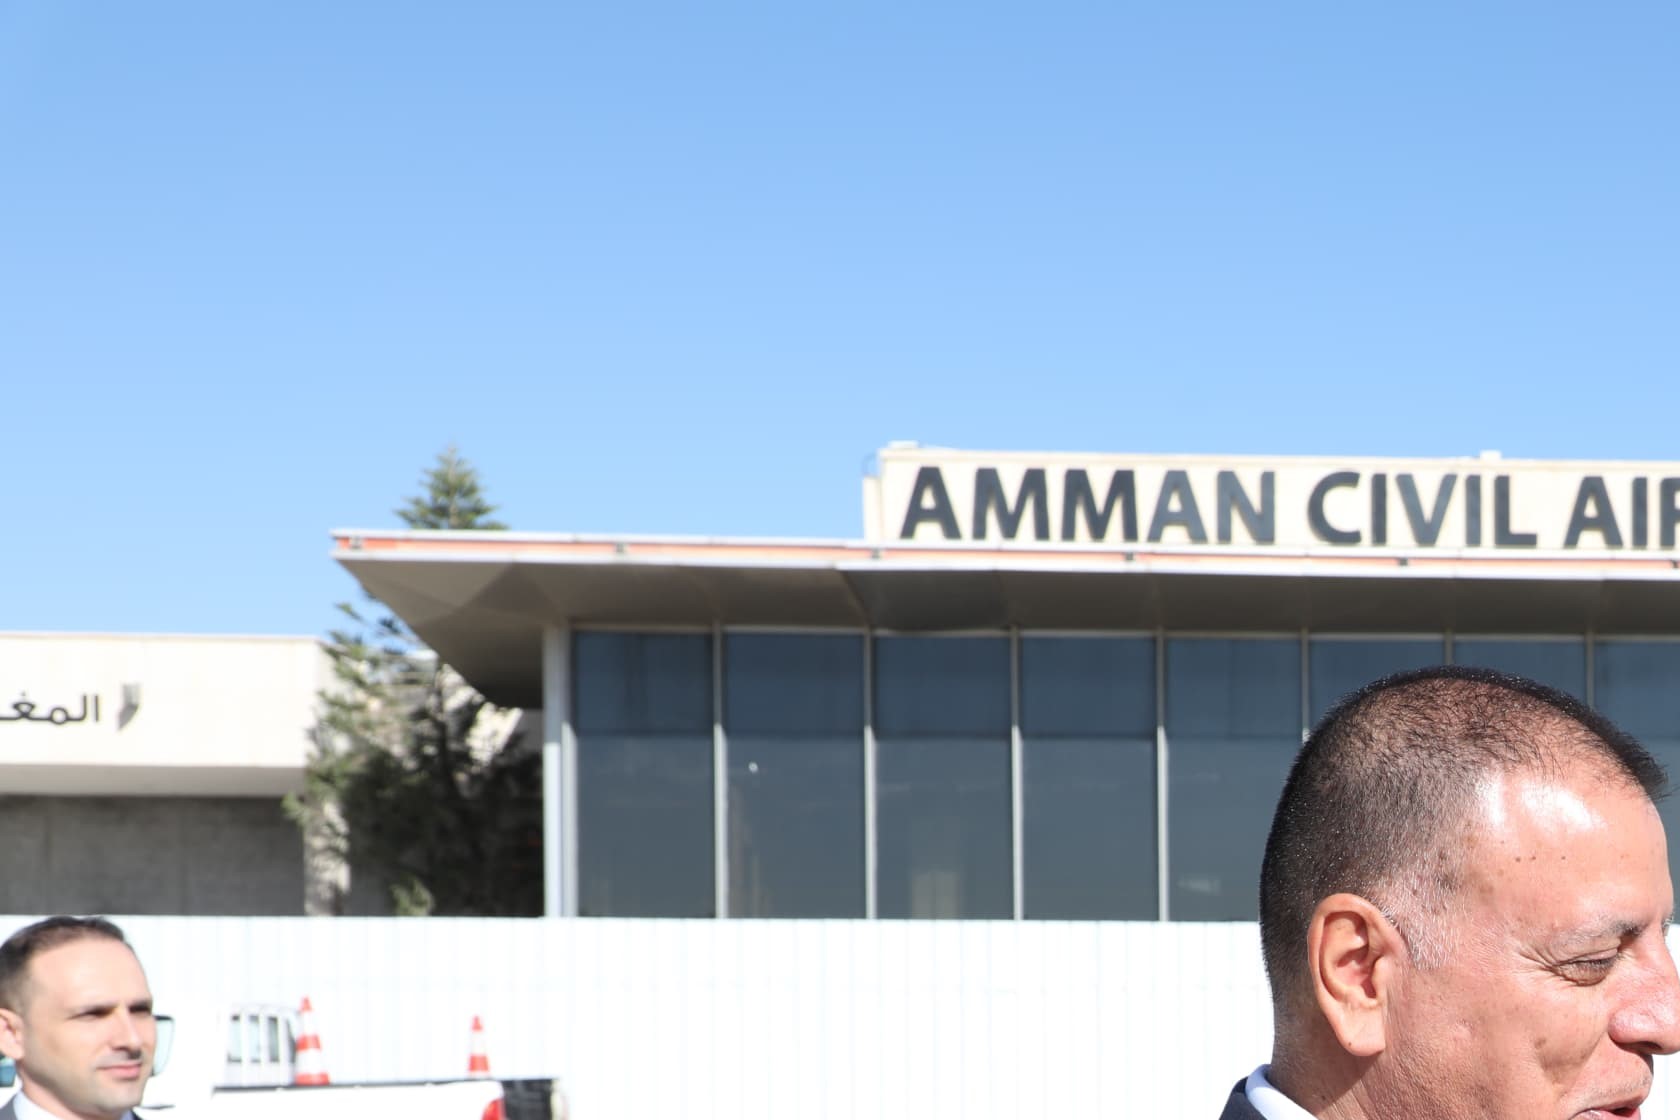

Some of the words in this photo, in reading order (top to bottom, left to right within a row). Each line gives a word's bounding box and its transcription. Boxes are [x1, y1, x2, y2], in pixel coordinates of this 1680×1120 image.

[899, 465, 1276, 546] AMMAN
[1306, 470, 1538, 549] CIVIL
[0, 690, 99, 726] المغ
